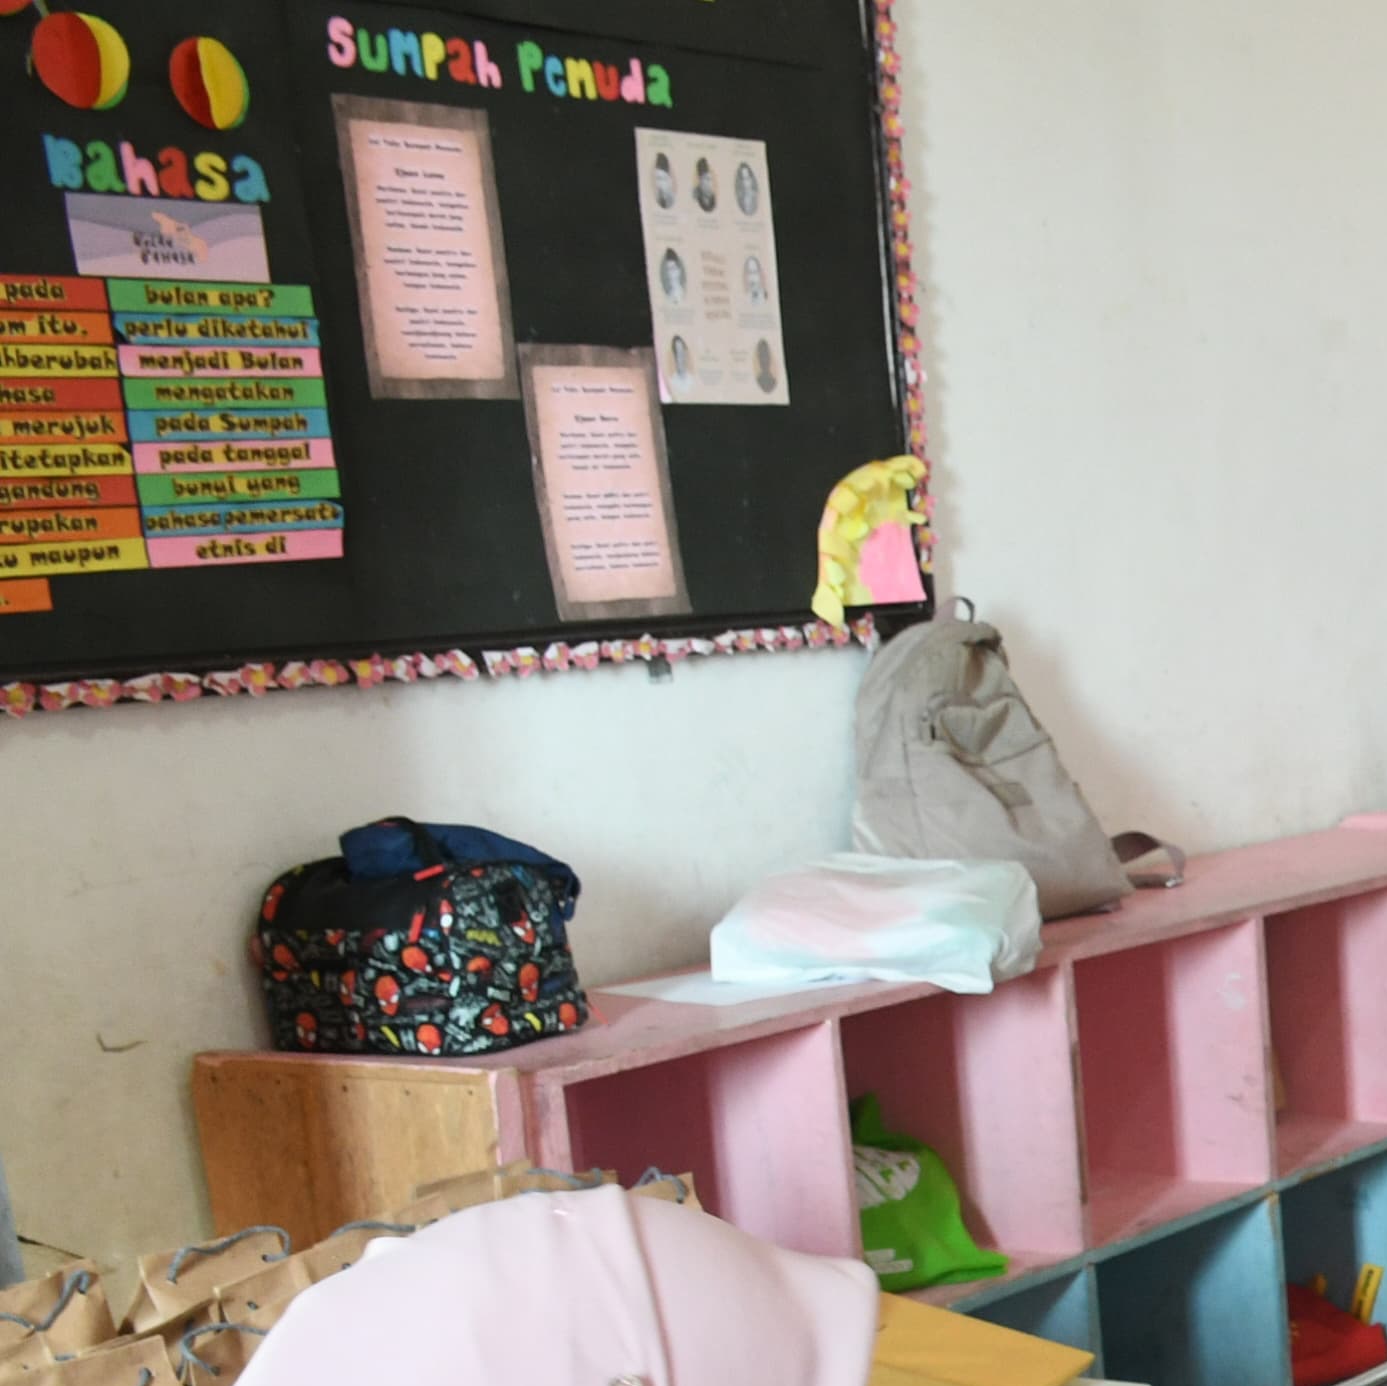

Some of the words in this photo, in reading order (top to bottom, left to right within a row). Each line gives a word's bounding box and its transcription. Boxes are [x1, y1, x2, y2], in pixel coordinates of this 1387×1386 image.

[5, 279, 65, 303] pada
[146, 285, 208, 306] bulan
[219, 289, 275, 312] apa?
[124, 320, 187, 342] perlu
[197, 319, 309, 339] diketahui
[139, 350, 229, 375] menjadi
[241, 350, 304, 371] Bulan
[155, 384, 294, 408] mengatakan
[13, 416, 116, 441] merujuk
[155, 415, 211, 437] pada
[219, 413, 308, 437] Sumpah
[159, 444, 213, 469] pada
[224, 442, 311, 466] tanggal
[172, 477, 236, 500] bunyi
[247, 475, 300, 497] yang
[30, 545, 120, 567] maupun
[195, 537, 257, 559] etnis
[265, 536, 287, 555] di
